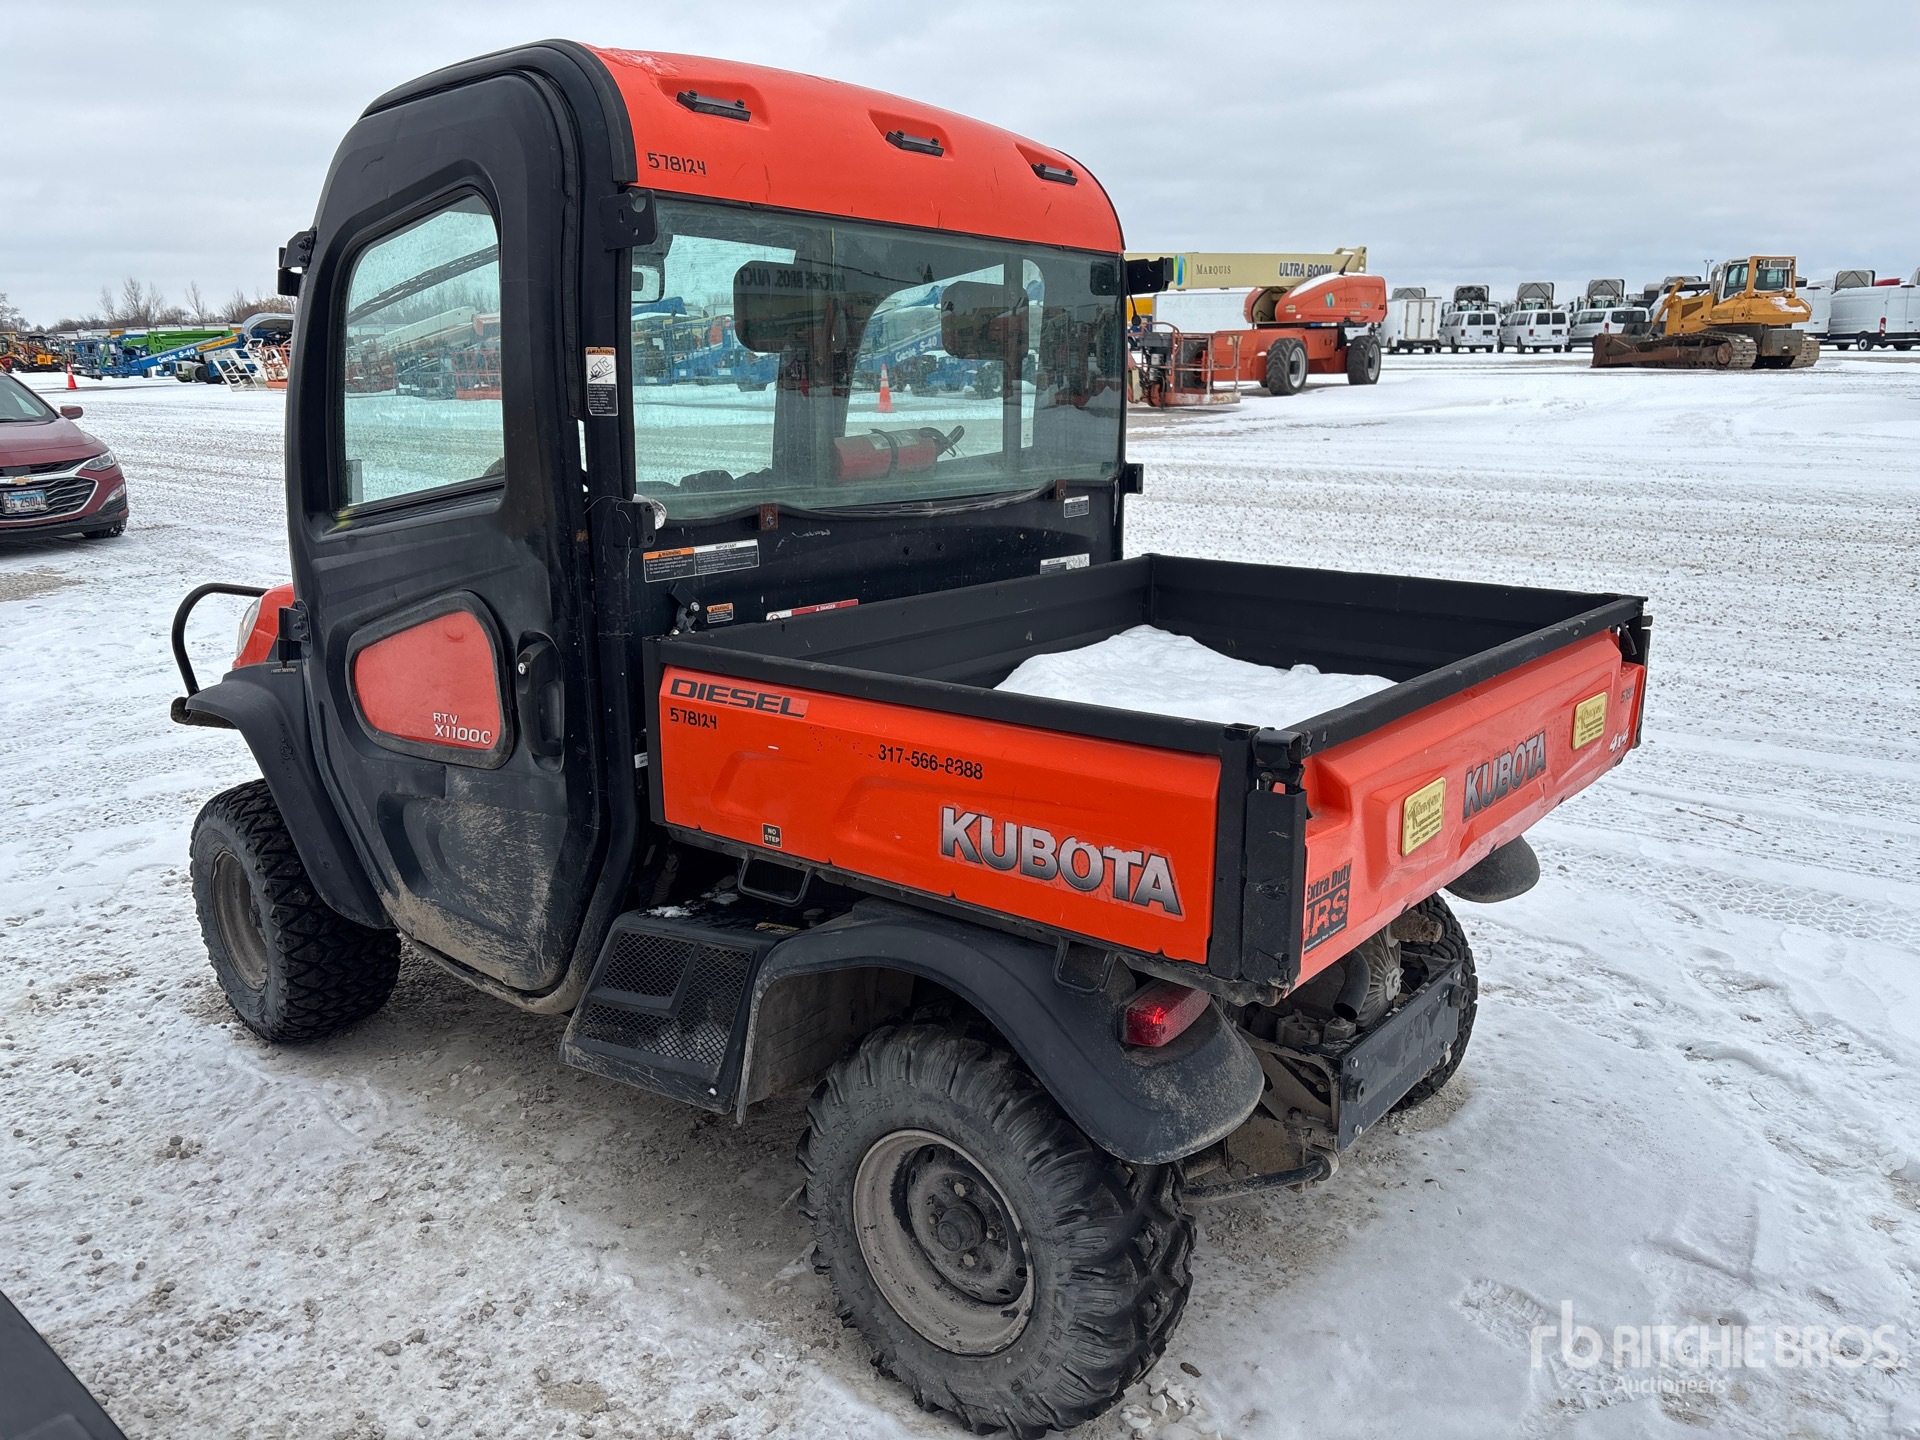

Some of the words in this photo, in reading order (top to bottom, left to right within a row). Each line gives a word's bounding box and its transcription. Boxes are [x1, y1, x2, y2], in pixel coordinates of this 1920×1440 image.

[646, 152, 706, 175] 578124
[1196, 264, 1232, 275] MARQUIS
[1279, 262, 1305, 277] ULTRA
[1307, 264, 1332, 278] BOOM
[920, 336, 938, 352] S-40
[156, 354, 176, 364] Genie
[178, 348, 195, 358] S-40
[670, 678, 804, 718] DIESEL
[433, 712, 458, 724] RTV
[670, 708, 717, 730] 578124
[434, 724, 492, 744] X1100C
[1463, 730, 1546, 819] KUBOTA
[764, 834, 780, 843] STEP
[767, 827, 777, 835] NO
[941, 806, 1182, 916] KUBOTA
[1308, 877, 1330, 900] Extra
[1332, 863, 1352, 888] Duty
[1304, 888, 1348, 941] IRS
